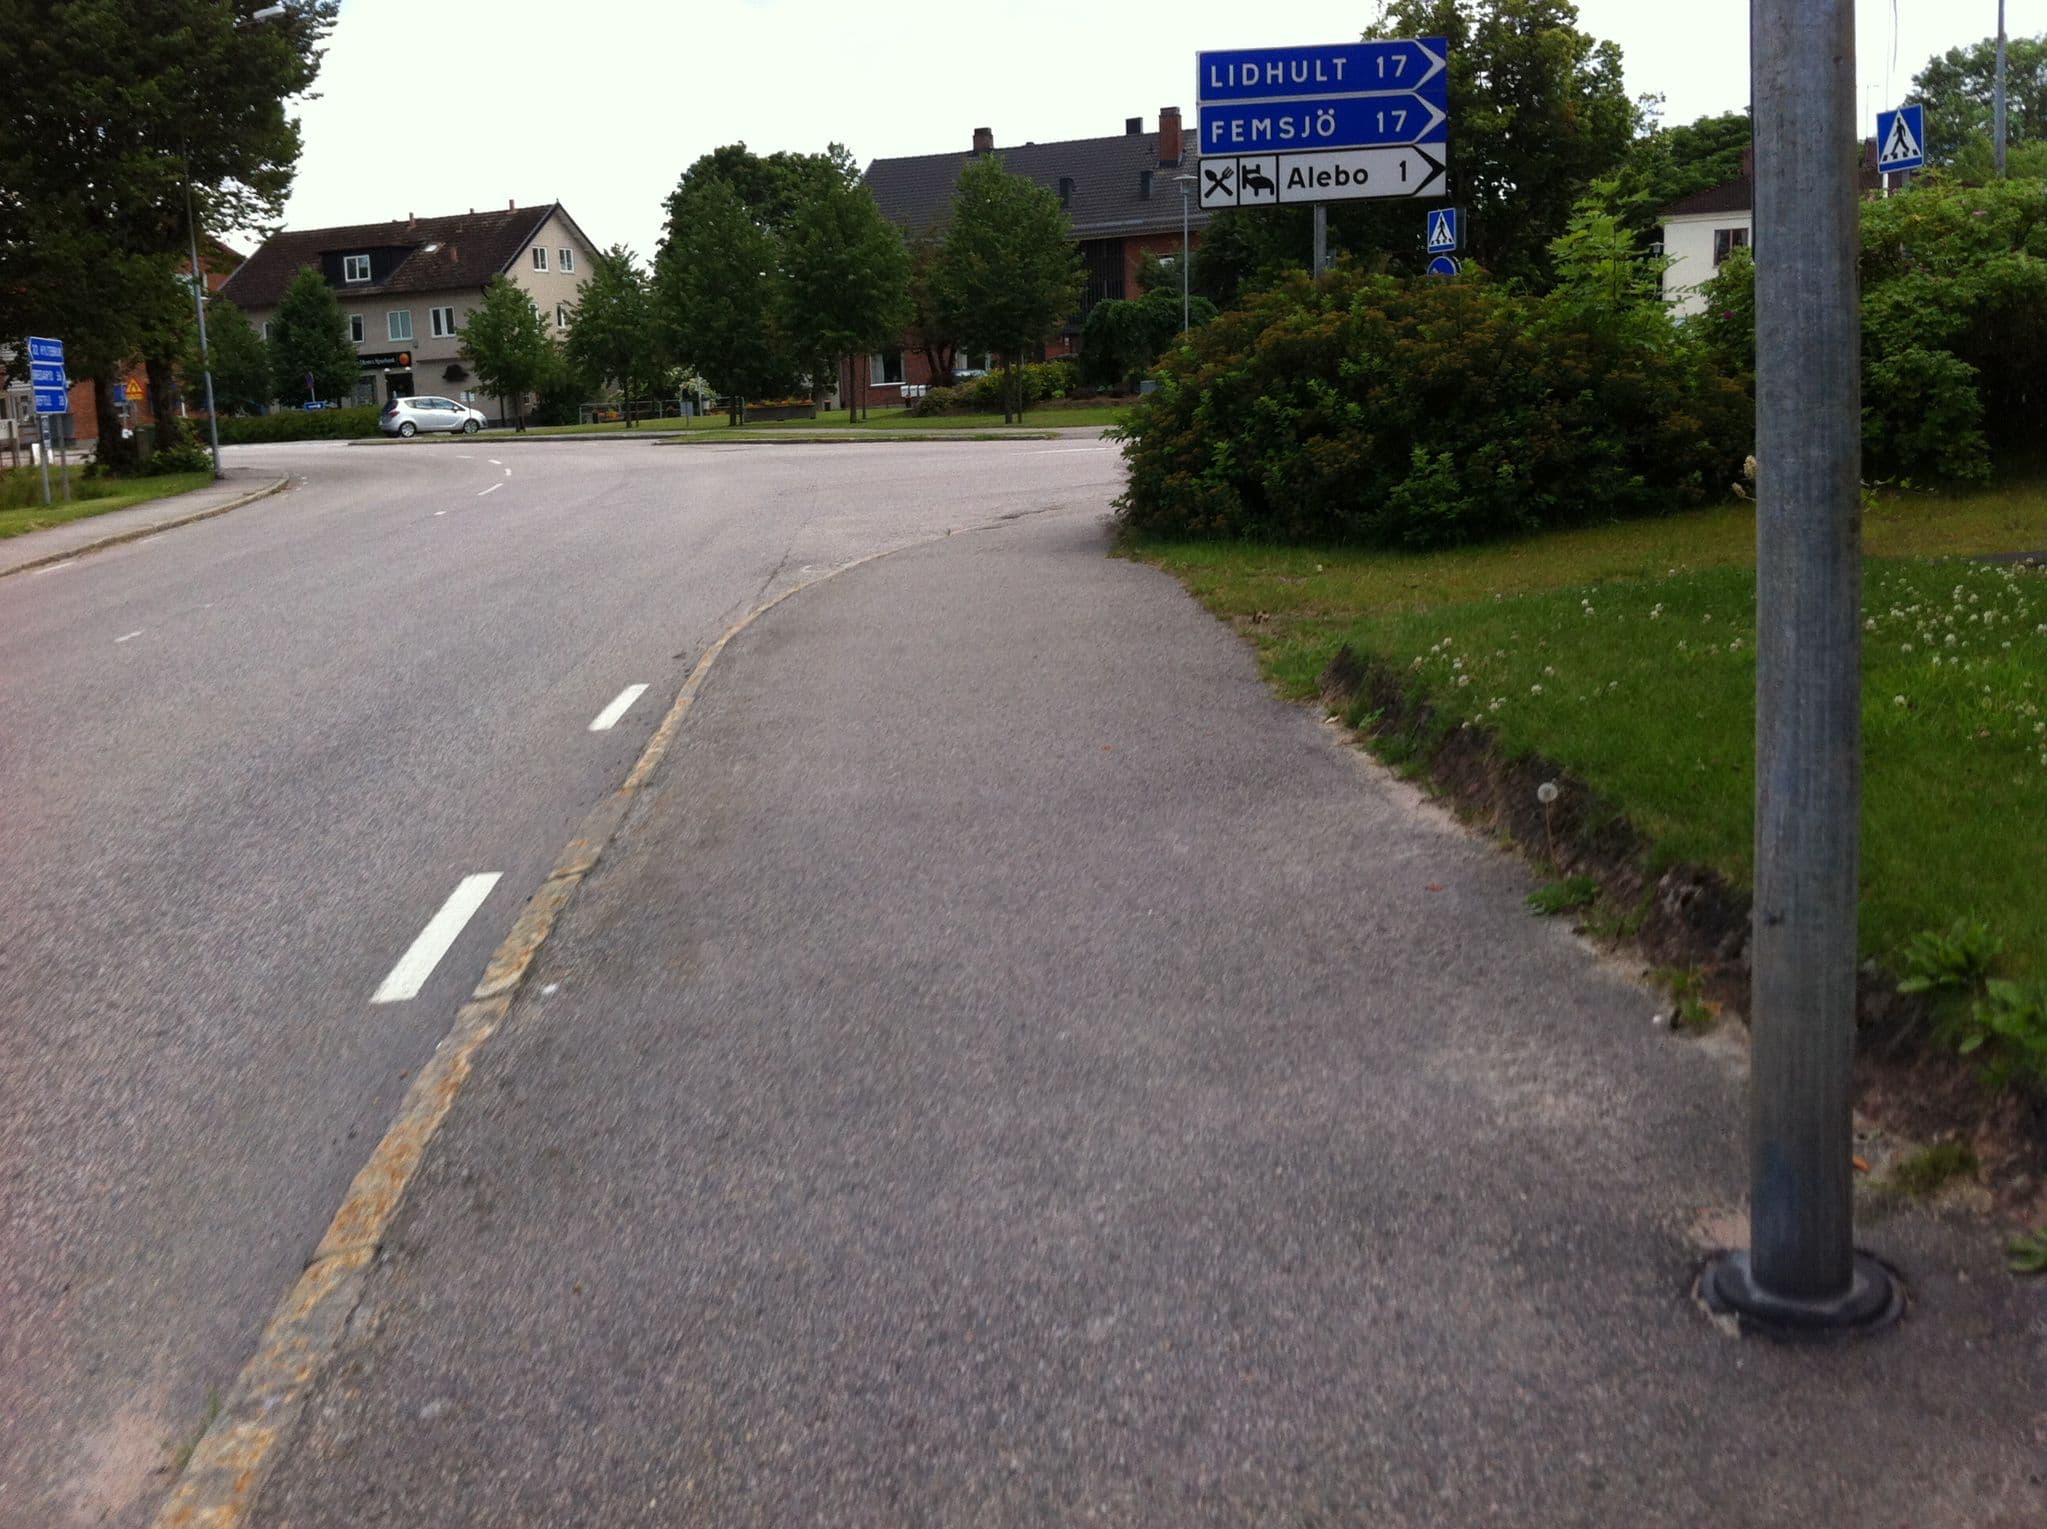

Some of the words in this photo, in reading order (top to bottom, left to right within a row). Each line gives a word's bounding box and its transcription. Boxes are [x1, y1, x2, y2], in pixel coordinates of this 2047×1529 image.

[1211, 58, 1347, 88] LIDHULT
[1376, 55, 1408, 78] 17
[1211, 108, 1336, 143] FEMSJÖ
[1376, 110, 1408, 133] 17
[1287, 165, 1369, 189] Alebo
[1399, 160, 1407, 182] 1
